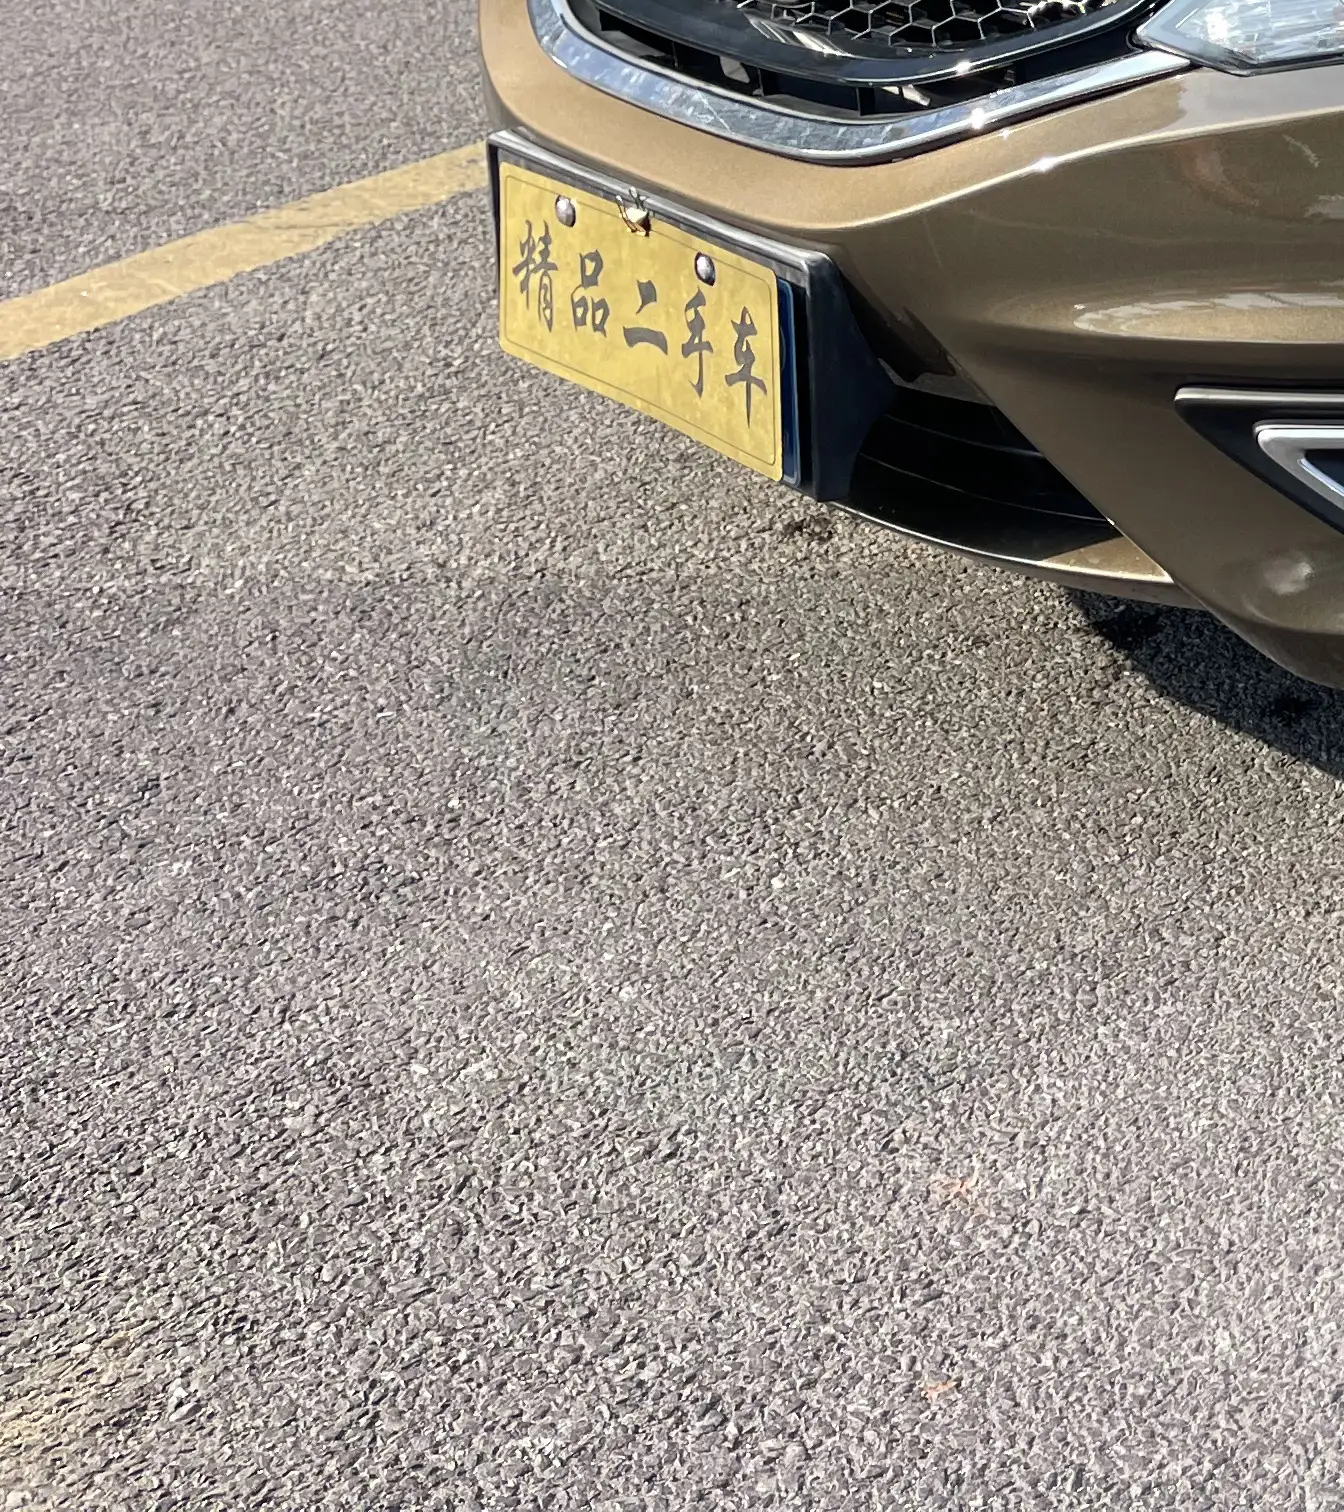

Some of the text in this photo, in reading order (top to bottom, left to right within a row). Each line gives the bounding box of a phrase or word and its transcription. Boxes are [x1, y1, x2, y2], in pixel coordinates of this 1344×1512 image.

[512, 219, 768, 429] 精品二手车
